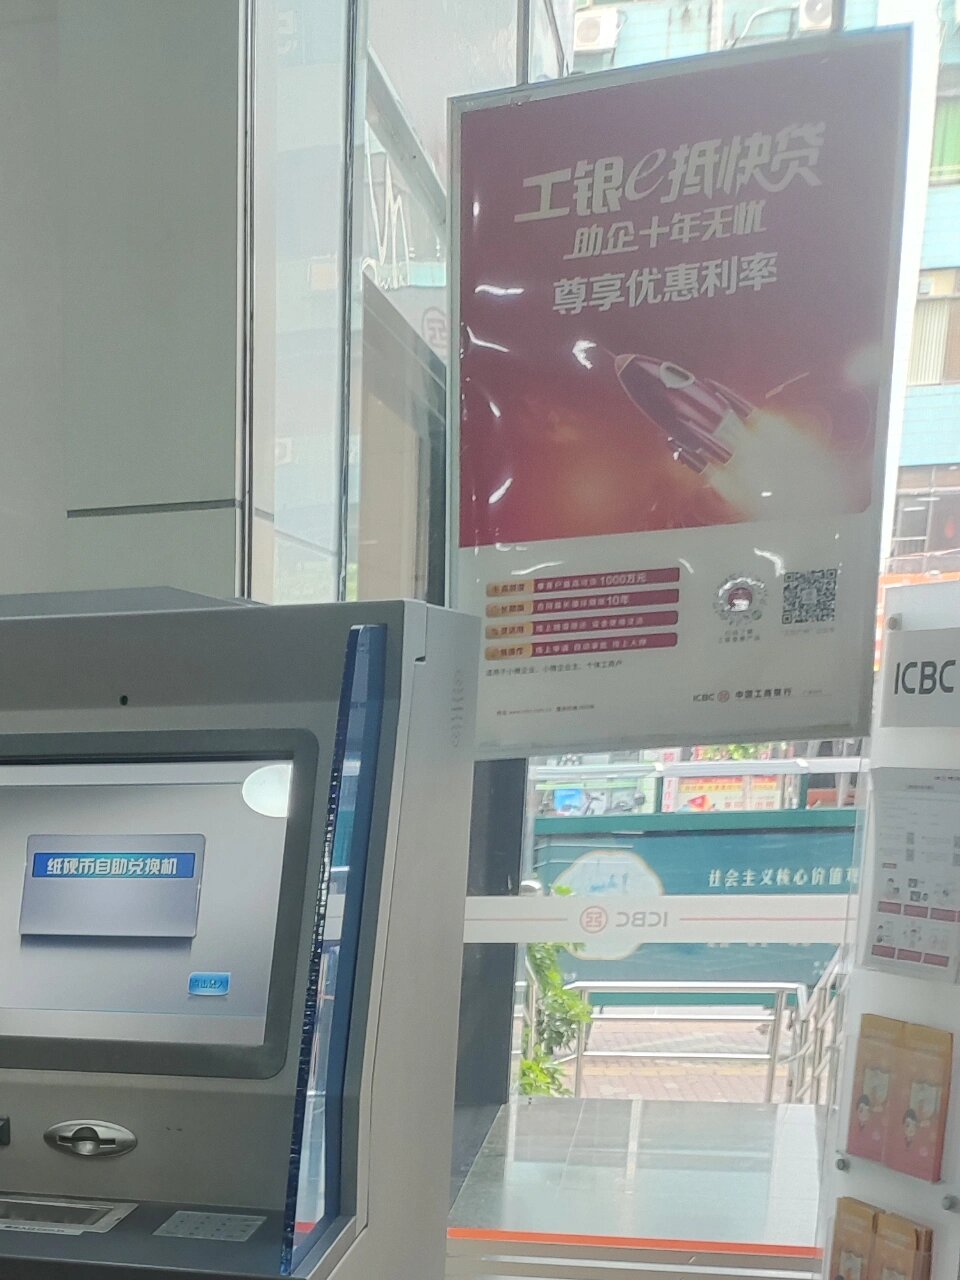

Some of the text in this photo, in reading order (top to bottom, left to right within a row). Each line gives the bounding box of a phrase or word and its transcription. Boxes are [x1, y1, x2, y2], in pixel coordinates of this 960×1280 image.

[514, 121, 826, 222] 工银e抵快贷
[563, 201, 768, 261] 助企十年无忧
[552, 252, 779, 314] 尊享优惠利率
[894, 660, 957, 695] ICBC
[46, 857, 178, 876] 纸硬币自助兑换机
